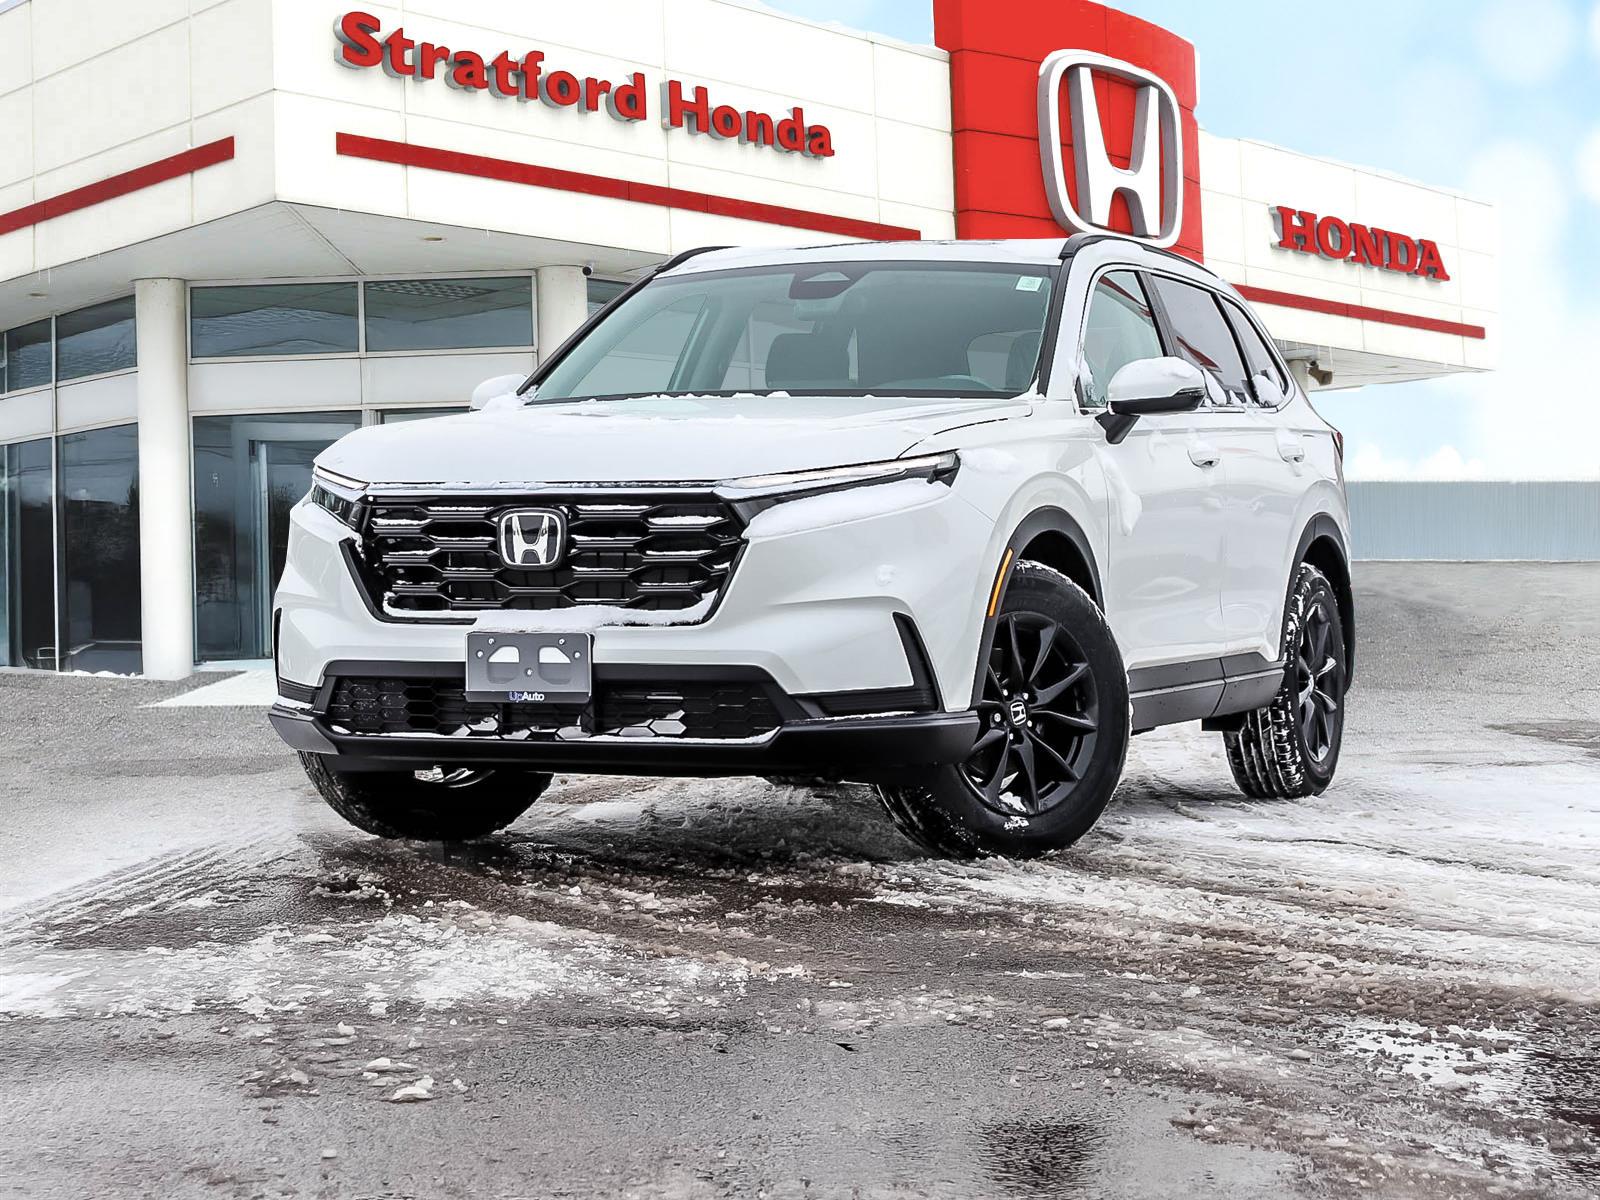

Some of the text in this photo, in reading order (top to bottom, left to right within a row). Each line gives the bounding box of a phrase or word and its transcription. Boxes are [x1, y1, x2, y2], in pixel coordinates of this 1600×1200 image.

[339, 11, 835, 158] Stratford Honda
[1272, 205, 1451, 281] HONDA
